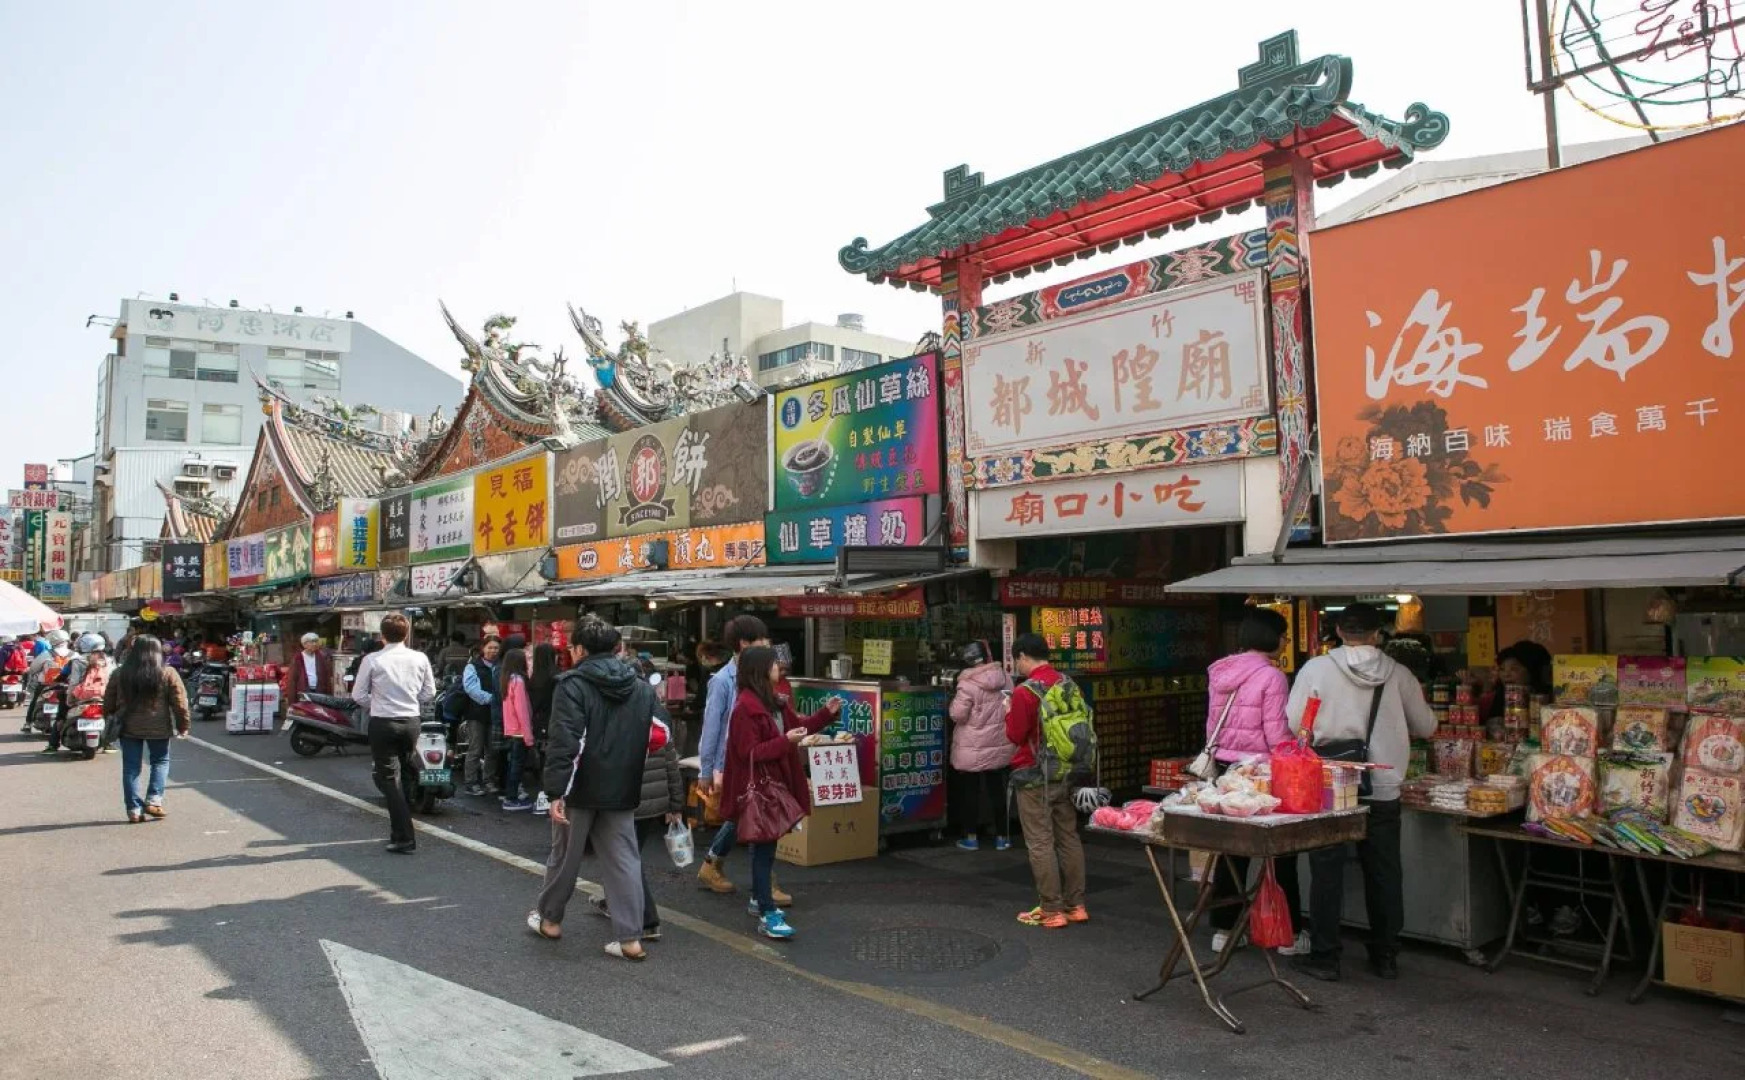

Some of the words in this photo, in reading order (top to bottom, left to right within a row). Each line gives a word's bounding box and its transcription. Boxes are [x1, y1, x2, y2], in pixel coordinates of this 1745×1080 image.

[1152, 309, 1175, 338] 竹
[807, 365, 931, 422] 冬瓜仙草絲
[989, 329, 1233, 436] 都城隍廟
[849, 420, 907, 448] 自製仙草
[1369, 423, 1512, 460] 海納百味
[1543, 397, 1719, 441] 瑞食萬千
[478, 500, 545, 550] 牛舌餅
[1005, 474, 1206, 527] 廟口小吃
[779, 509, 907, 553] 仙草撞奶
